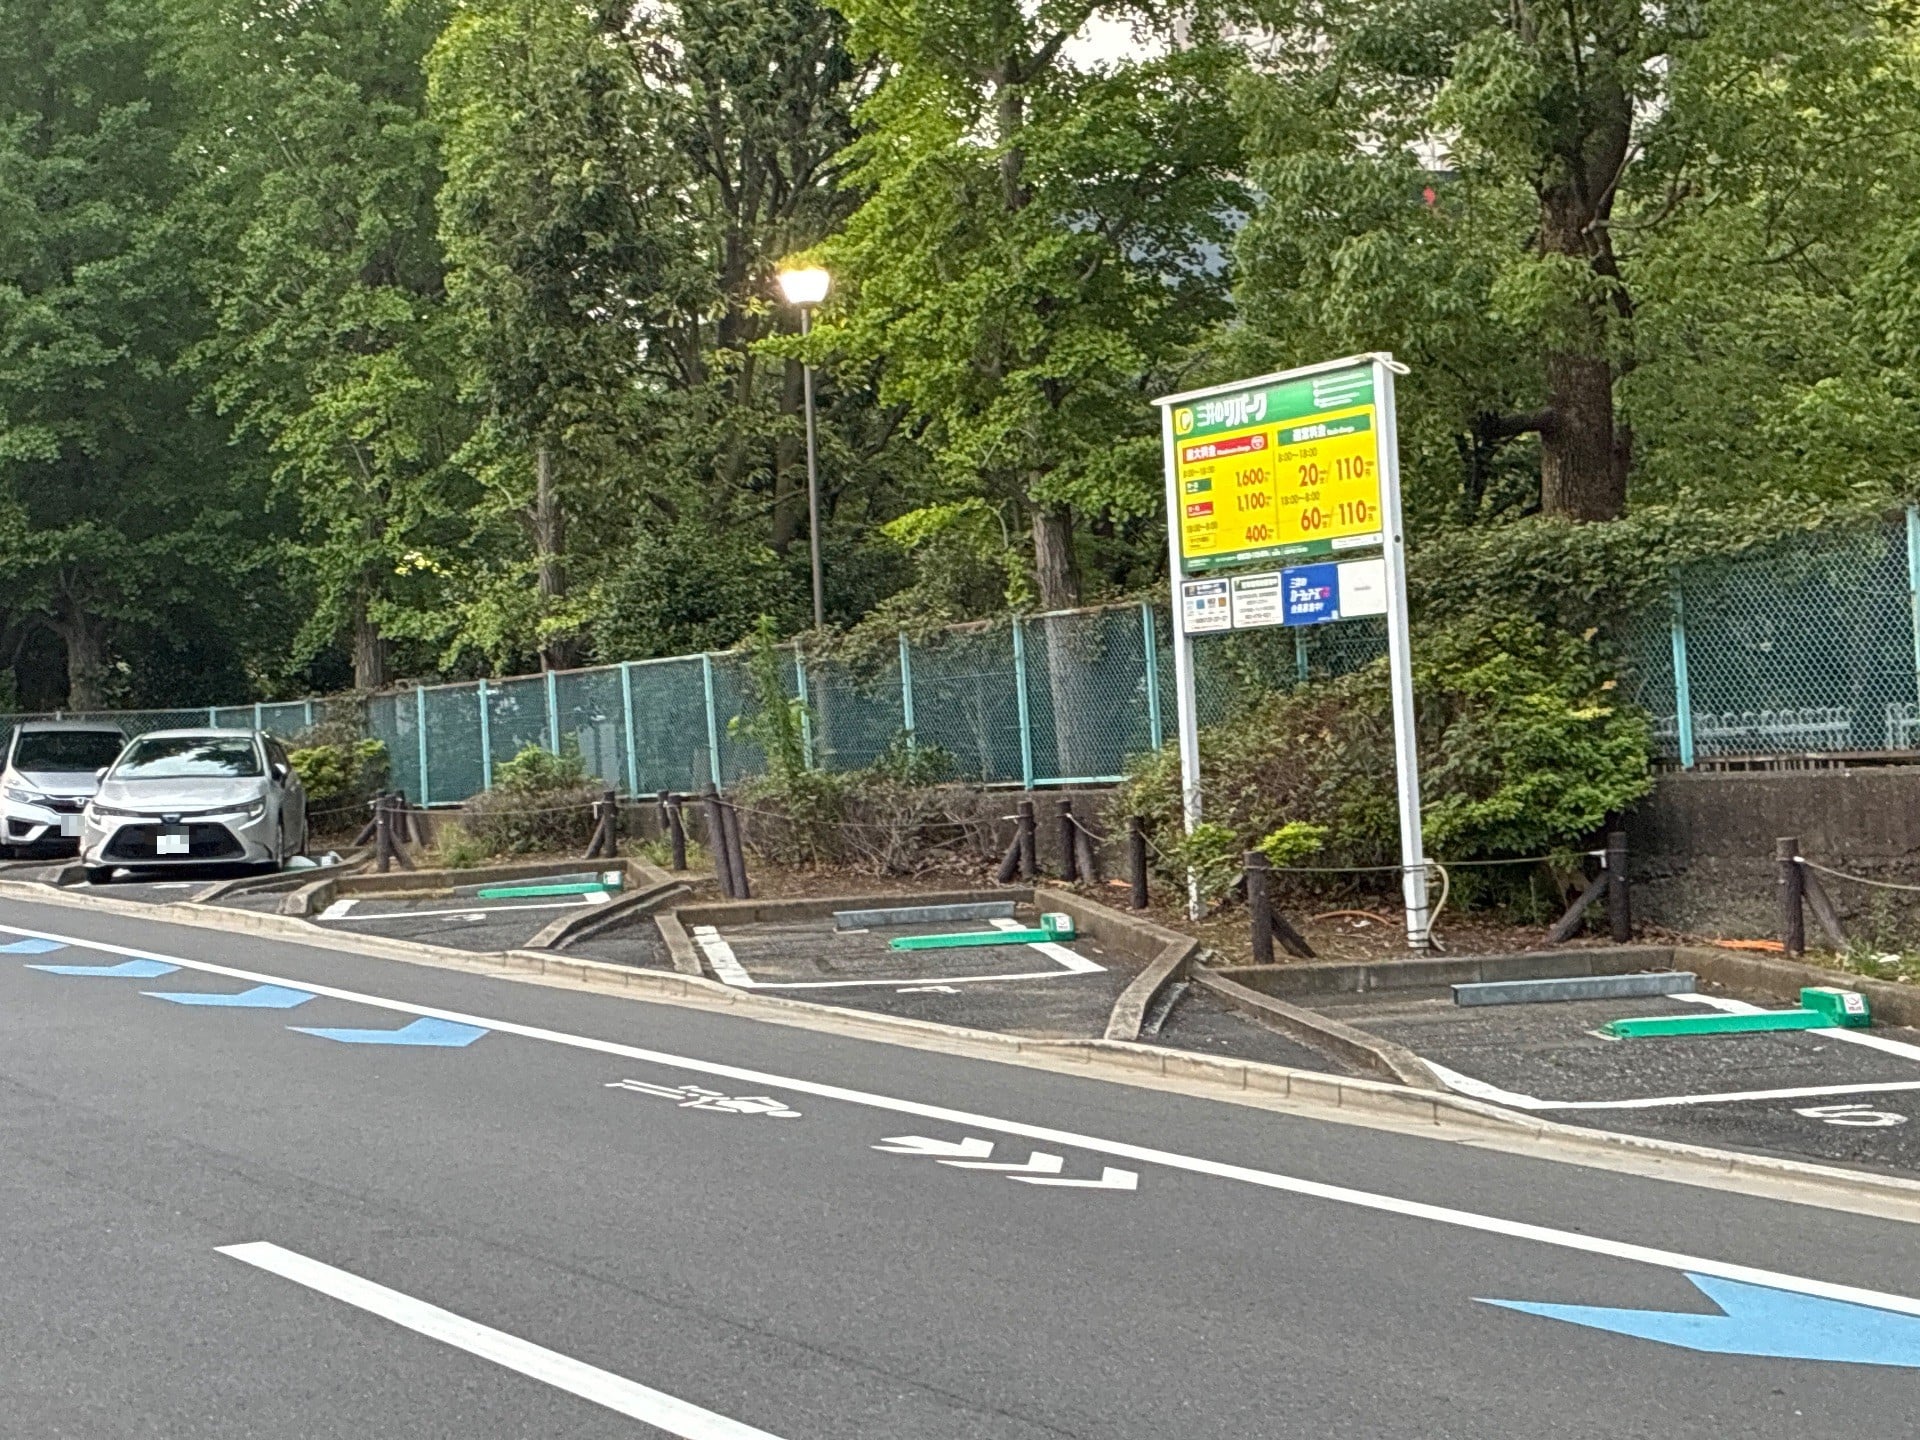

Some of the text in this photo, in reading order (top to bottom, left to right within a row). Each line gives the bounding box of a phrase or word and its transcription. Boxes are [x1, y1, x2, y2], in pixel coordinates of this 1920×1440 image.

[1299, 463, 1318, 487] 20
[1336, 456, 1363, 480] 110
[1301, 507, 1320, 531] 60
[1339, 500, 1366, 525] 110
[1245, 524, 1267, 542] 400
[1791, 1104, 1908, 1126] 5
